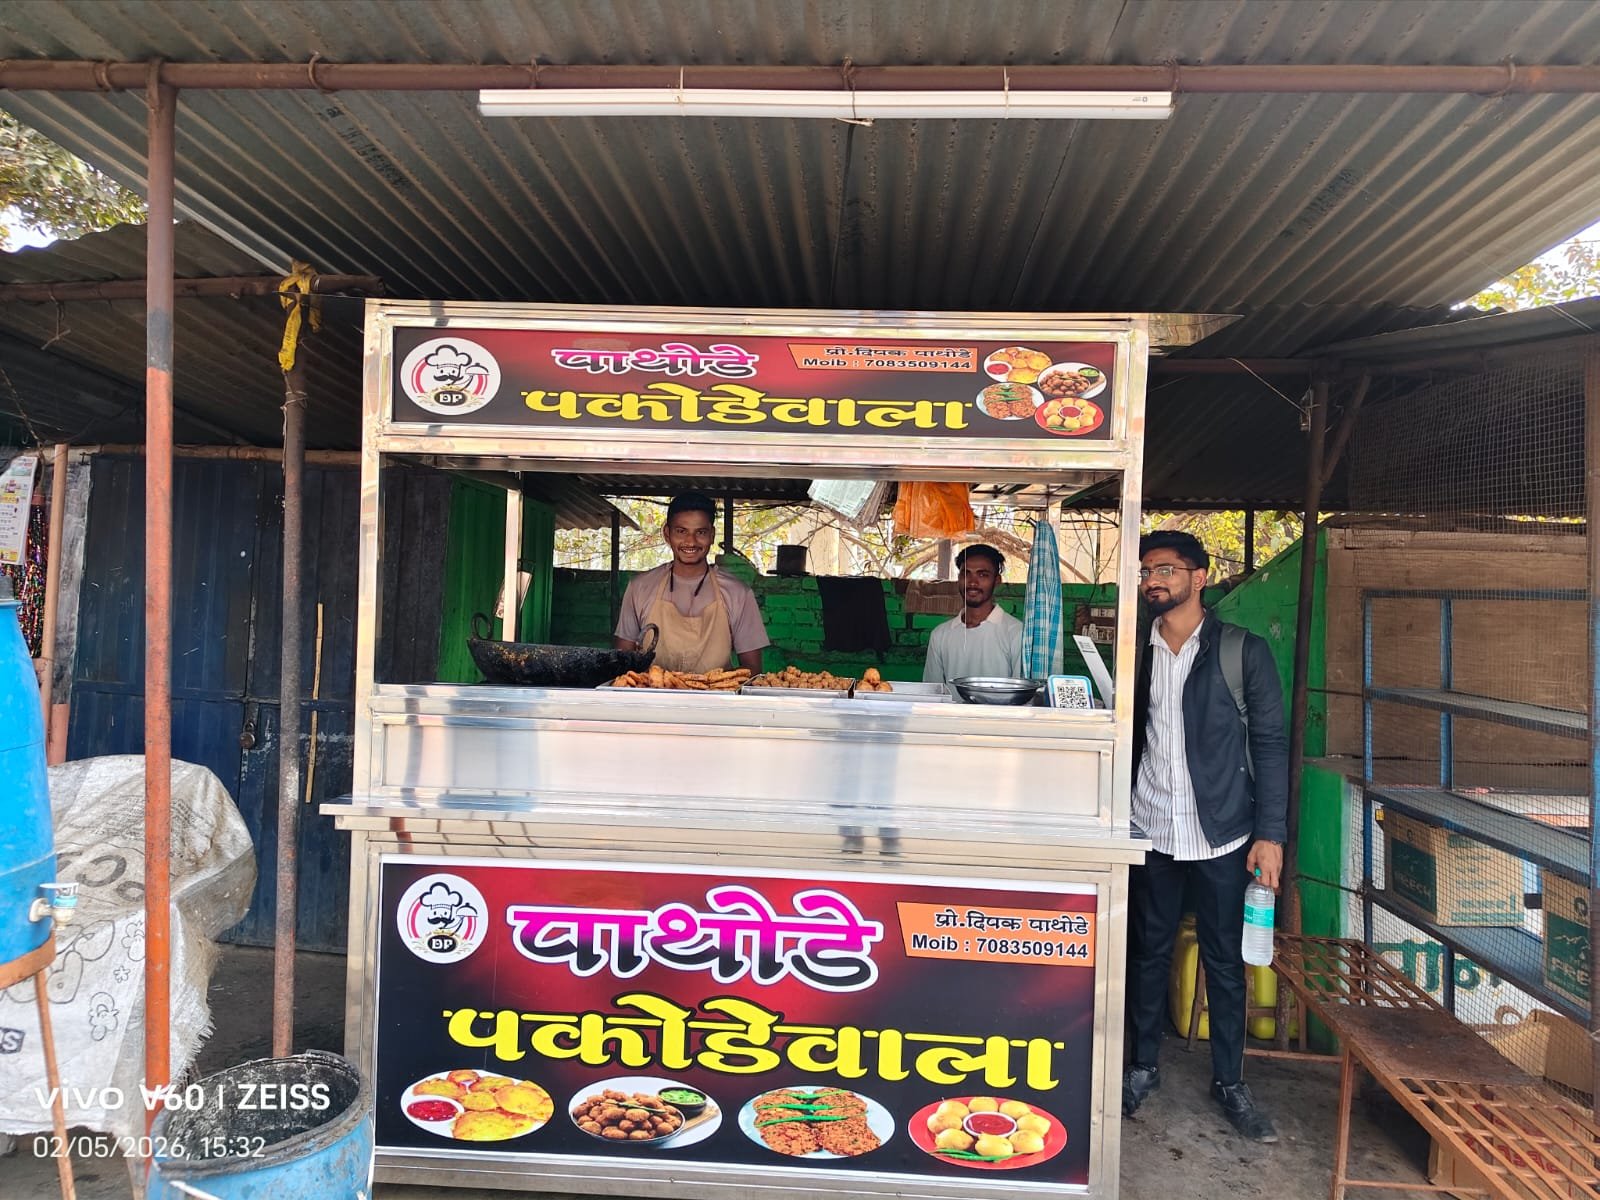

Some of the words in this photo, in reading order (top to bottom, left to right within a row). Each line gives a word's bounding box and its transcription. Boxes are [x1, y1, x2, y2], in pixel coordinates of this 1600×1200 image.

[803, 358, 847, 366] Moib
[864, 359, 972, 369] 7083509144
[521, 382, 973, 430] पकोडेवाला
[1028, 915, 1089, 935] पाथोडे
[912, 934, 958, 951] Moib
[976, 938, 1089, 958] 7083509144
[442, 994, 1065, 1091] पकोडेवाला
